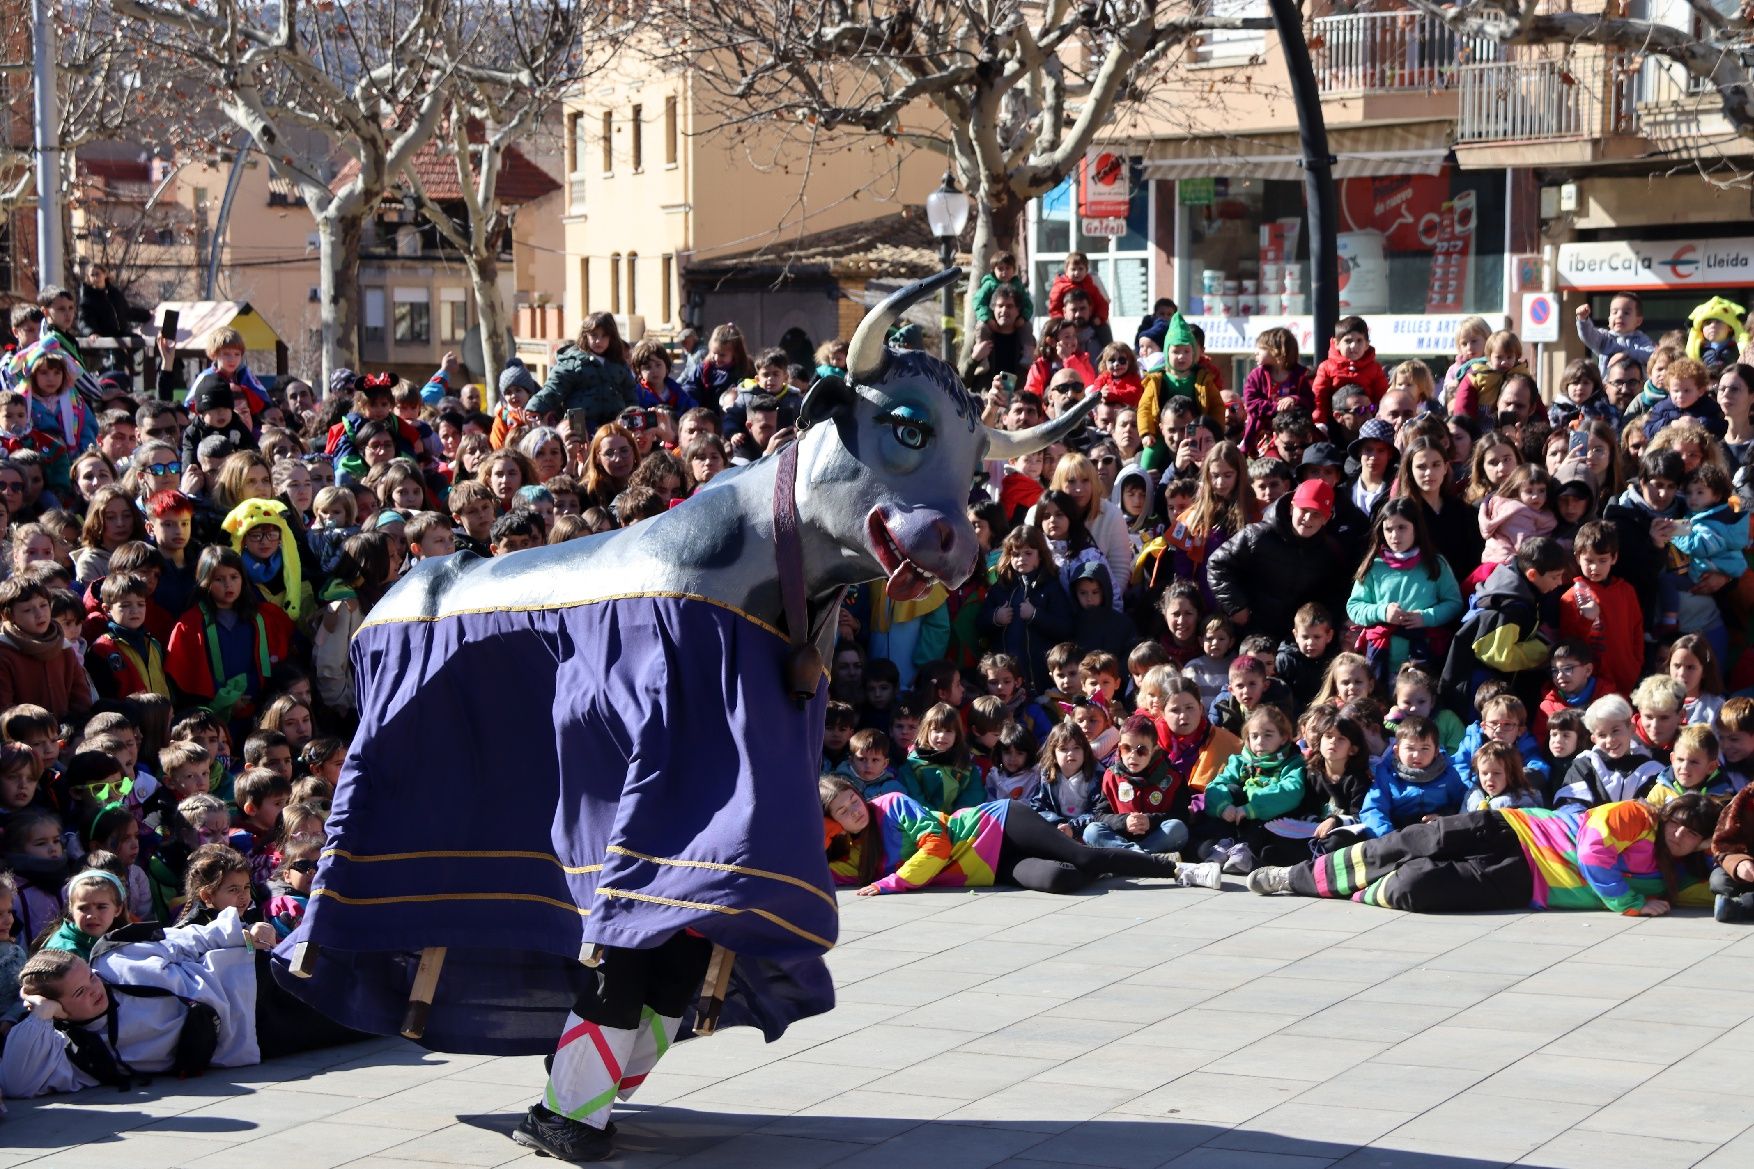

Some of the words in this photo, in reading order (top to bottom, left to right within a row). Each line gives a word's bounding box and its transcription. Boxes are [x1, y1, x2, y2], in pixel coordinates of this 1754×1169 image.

[1568, 250, 1652, 276] iberCaja
[1706, 253, 1749, 268] Lleida
[1393, 320, 1431, 333] BELLES
